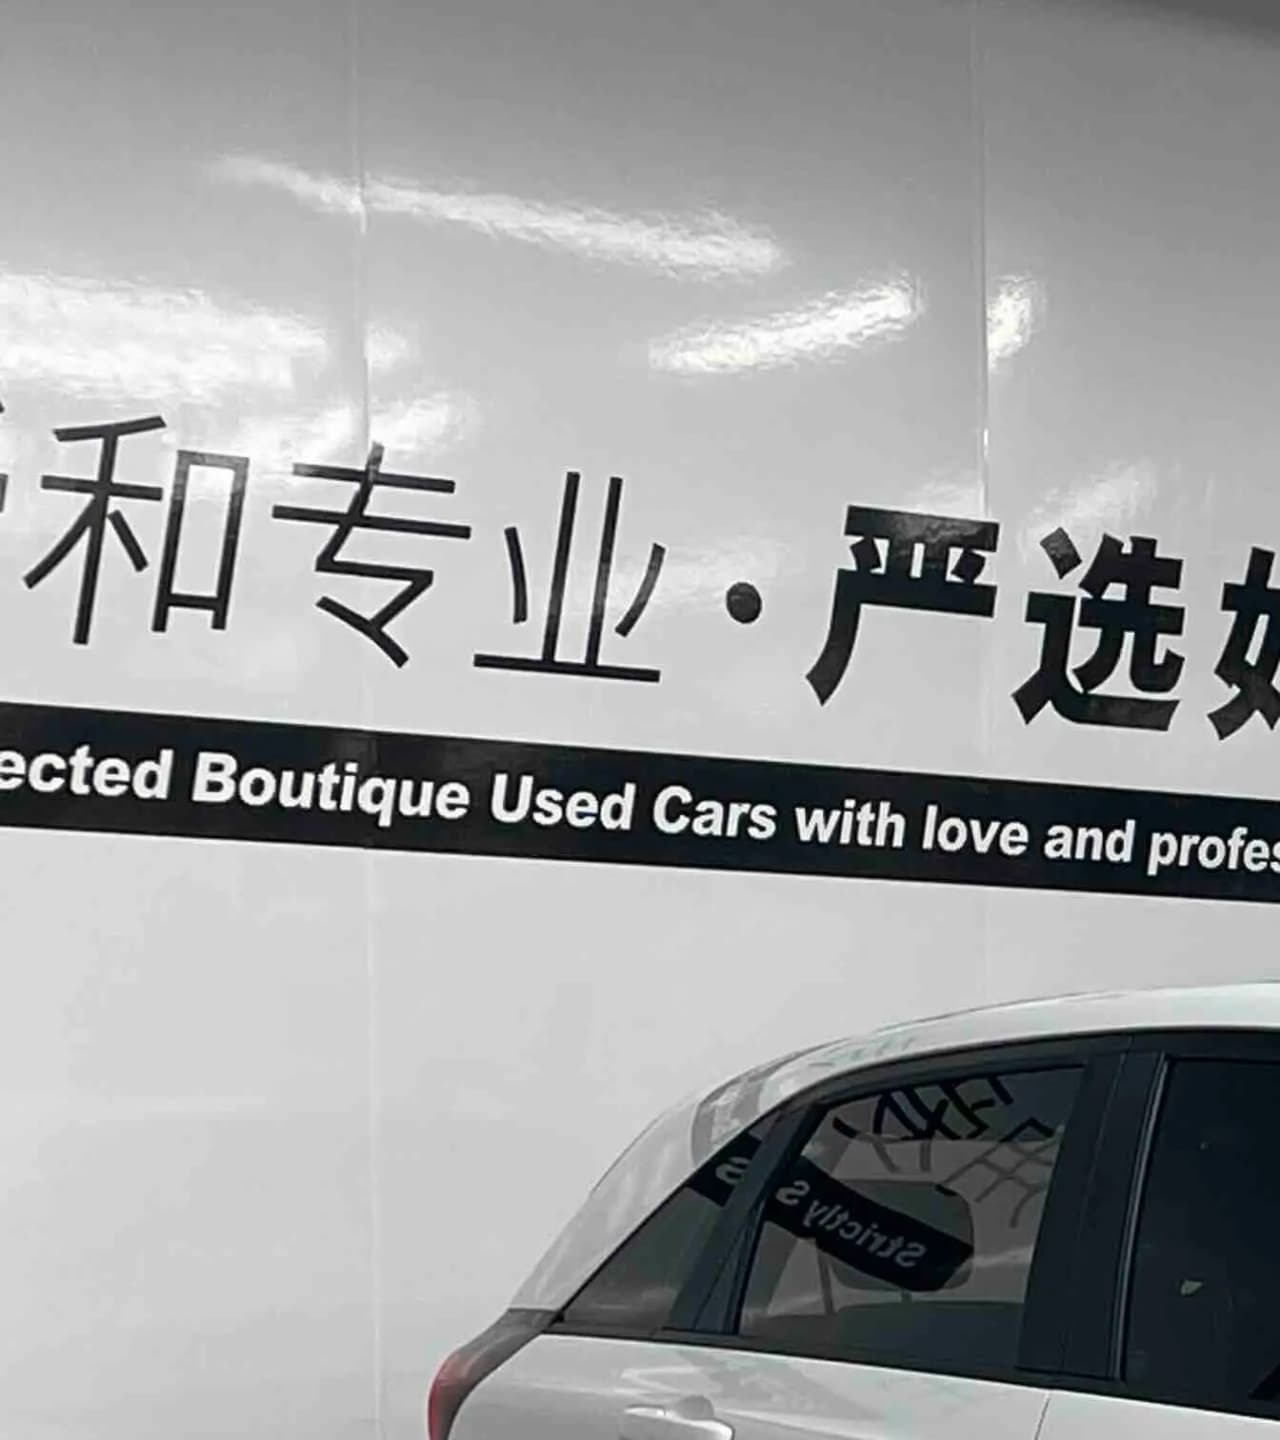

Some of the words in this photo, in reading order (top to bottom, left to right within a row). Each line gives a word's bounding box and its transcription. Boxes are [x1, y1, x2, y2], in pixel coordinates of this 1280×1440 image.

[192, 751, 470, 827] Boutique
[490, 773, 636, 831] Used
[653, 785, 777, 839] Cars
[795, 799, 906, 848] with
[922, 804, 1029, 856] love
[1044, 819, 1136, 863] and
